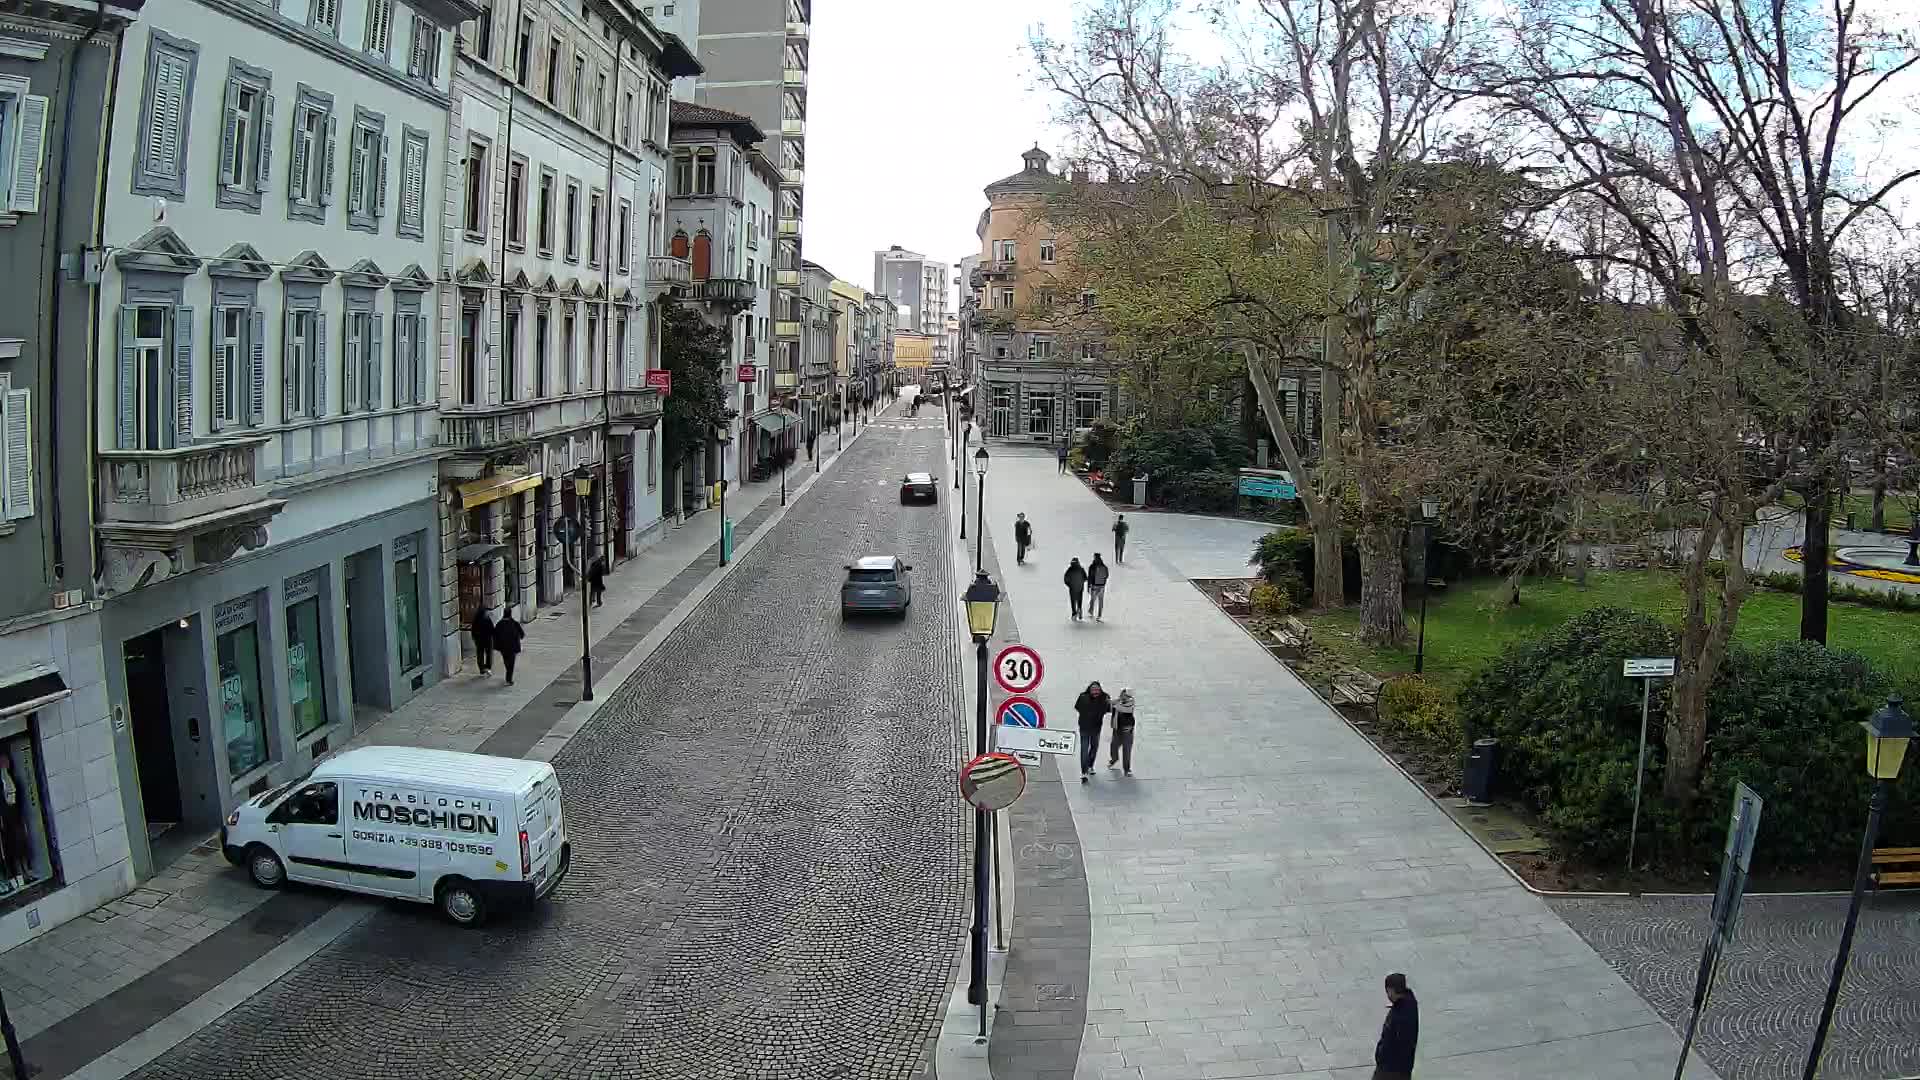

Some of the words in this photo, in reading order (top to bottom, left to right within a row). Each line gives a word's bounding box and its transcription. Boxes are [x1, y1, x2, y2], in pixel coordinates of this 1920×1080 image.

[1005, 659, 1032, 680] 30
[1038, 738, 1070, 750] Dante
[360, 790, 493, 811] TRASLOCHI
[353, 801, 498, 836] MOSCHION
[352, 830, 395, 844] GORIZIA
